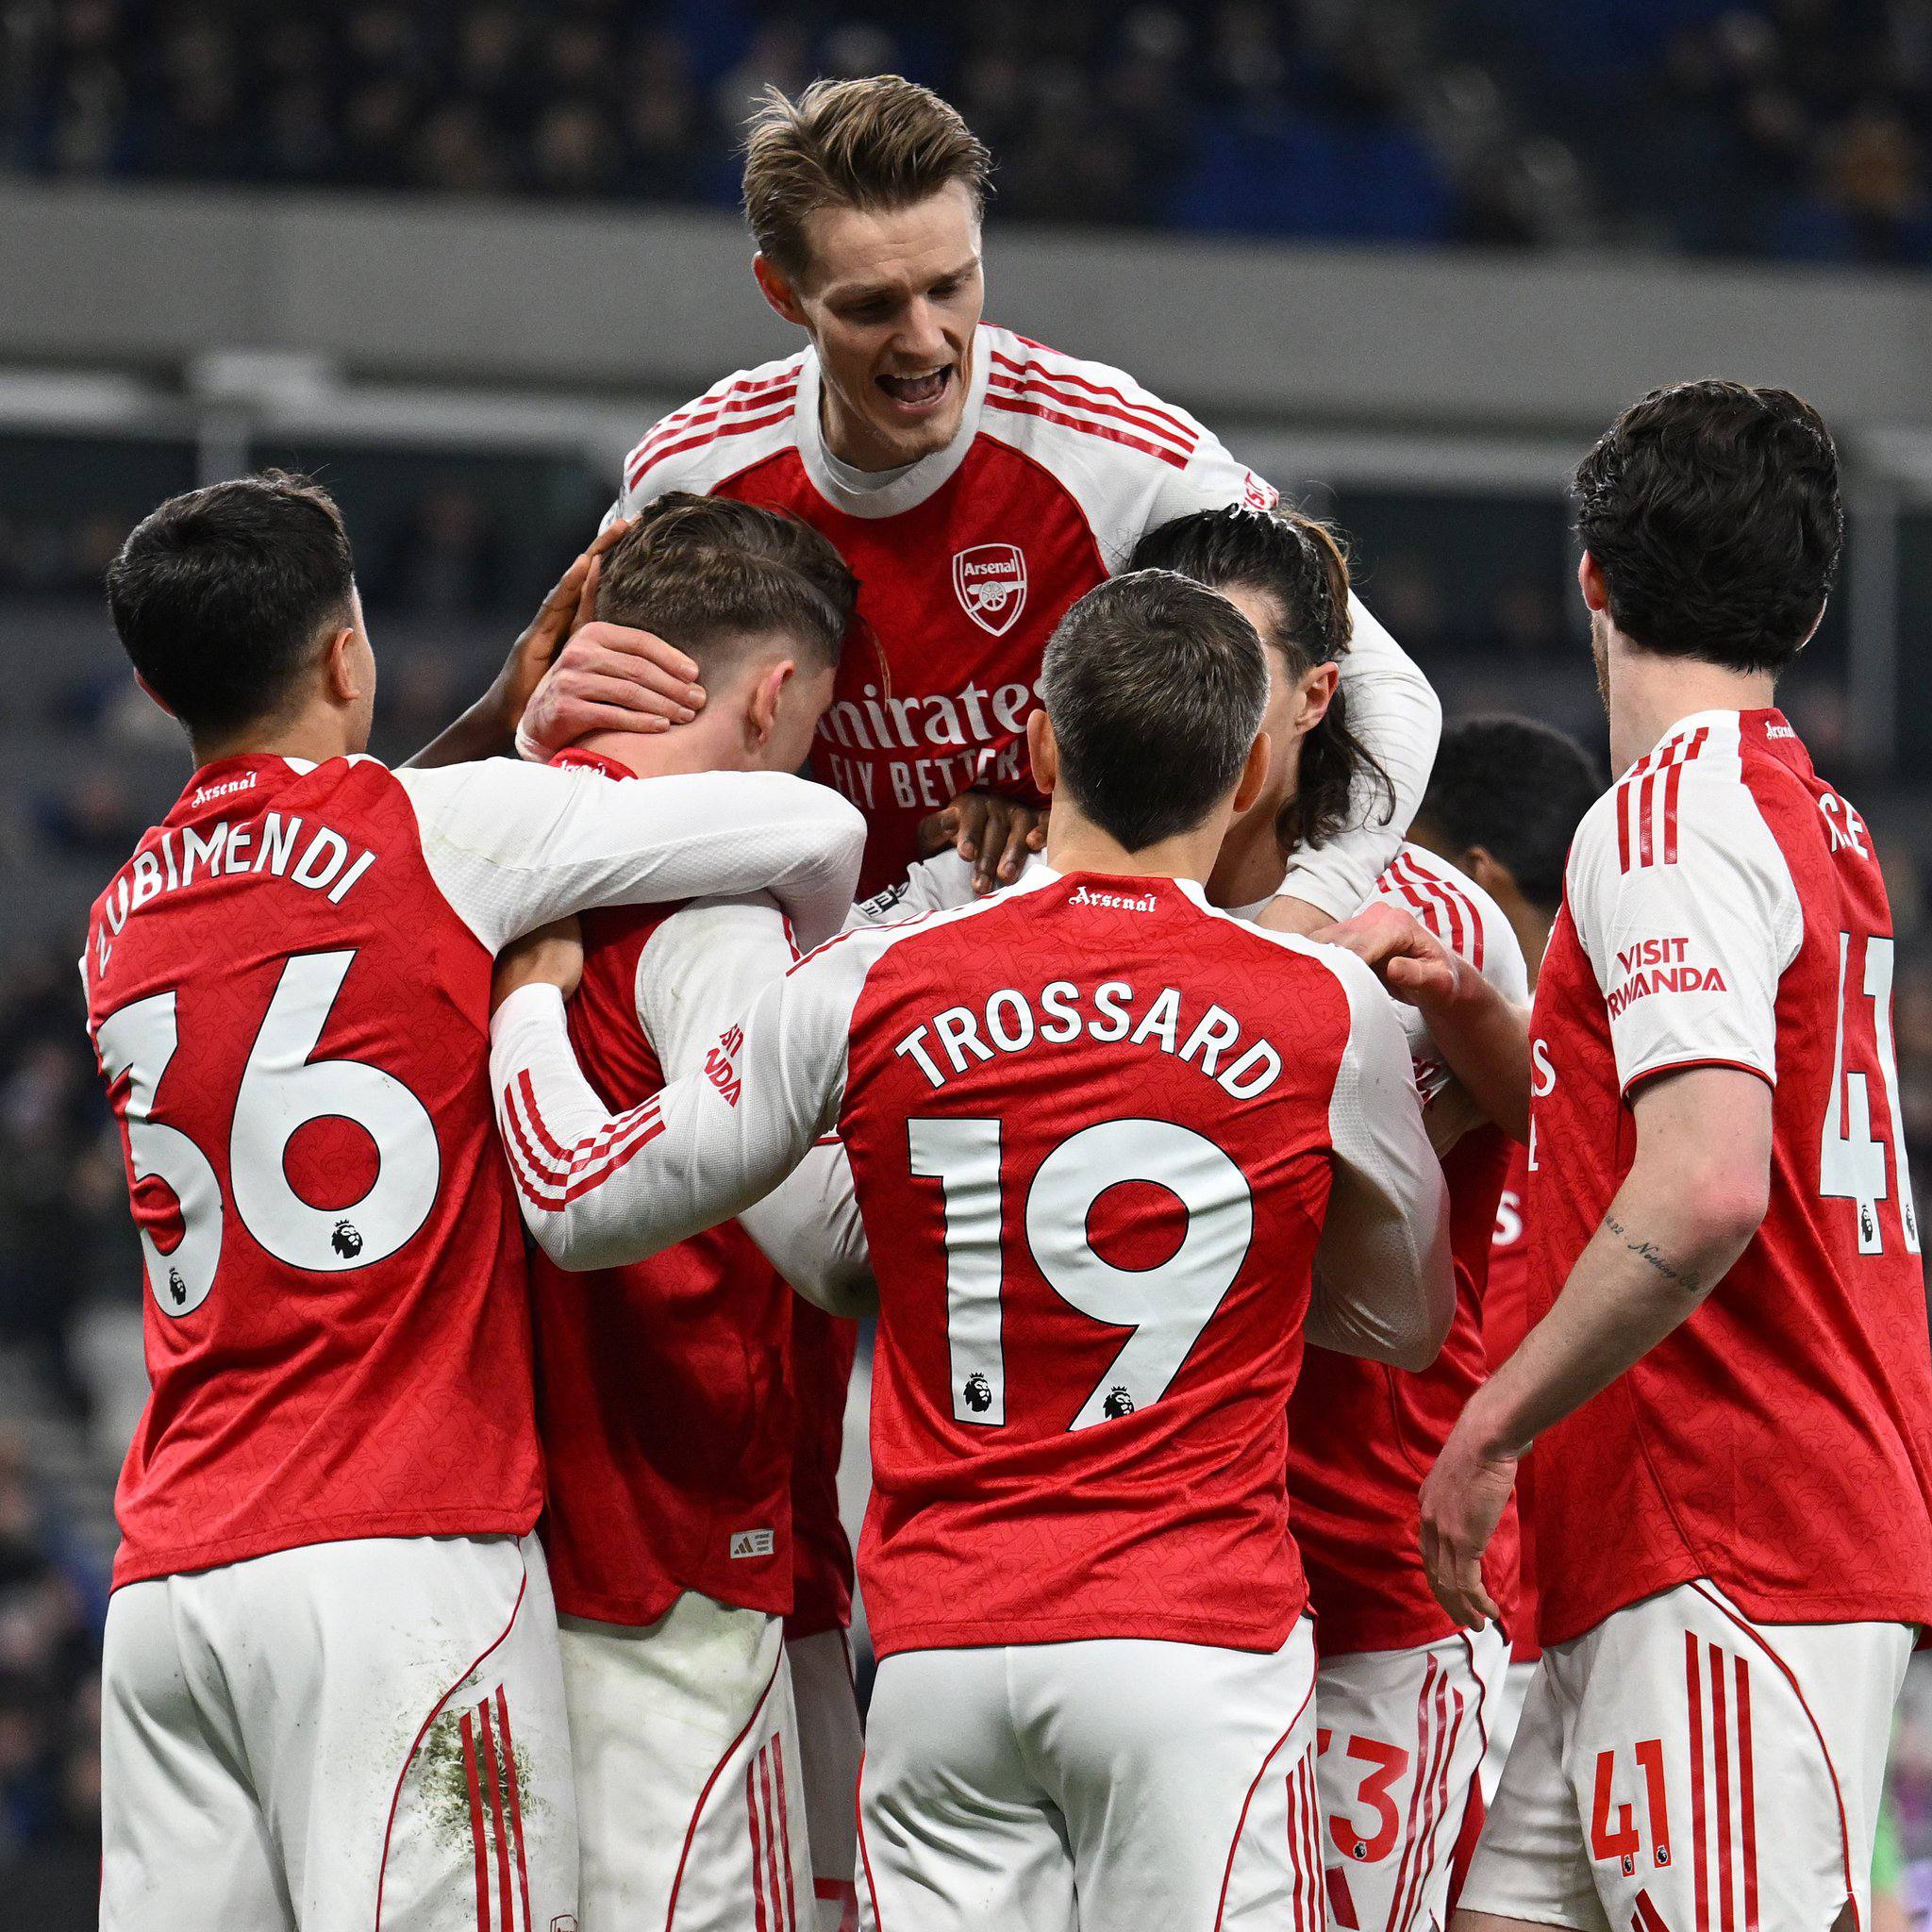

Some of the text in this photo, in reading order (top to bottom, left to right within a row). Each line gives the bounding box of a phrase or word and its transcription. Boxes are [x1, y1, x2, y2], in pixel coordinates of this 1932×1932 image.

[964, 558, 1015, 576] Arsenal
[818, 680, 1045, 749] mirate
[192, 772, 257, 808] Arsenal
[889, 741, 1020, 809] BETTER
[95, 811, 377, 978] ZUBIMENDI
[1068, 886, 1157, 912] Arsenal
[1617, 938, 1689, 974] VISIT
[1607, 967, 1727, 1022] RWANDA
[894, 981, 1283, 1101] TROSSARD
[1819, 930, 1922, 1256] 41
[95, 948, 441, 1318] 36
[907, 1118, 1254, 1433] 19
[1591, 1739, 1672, 1877] 41
